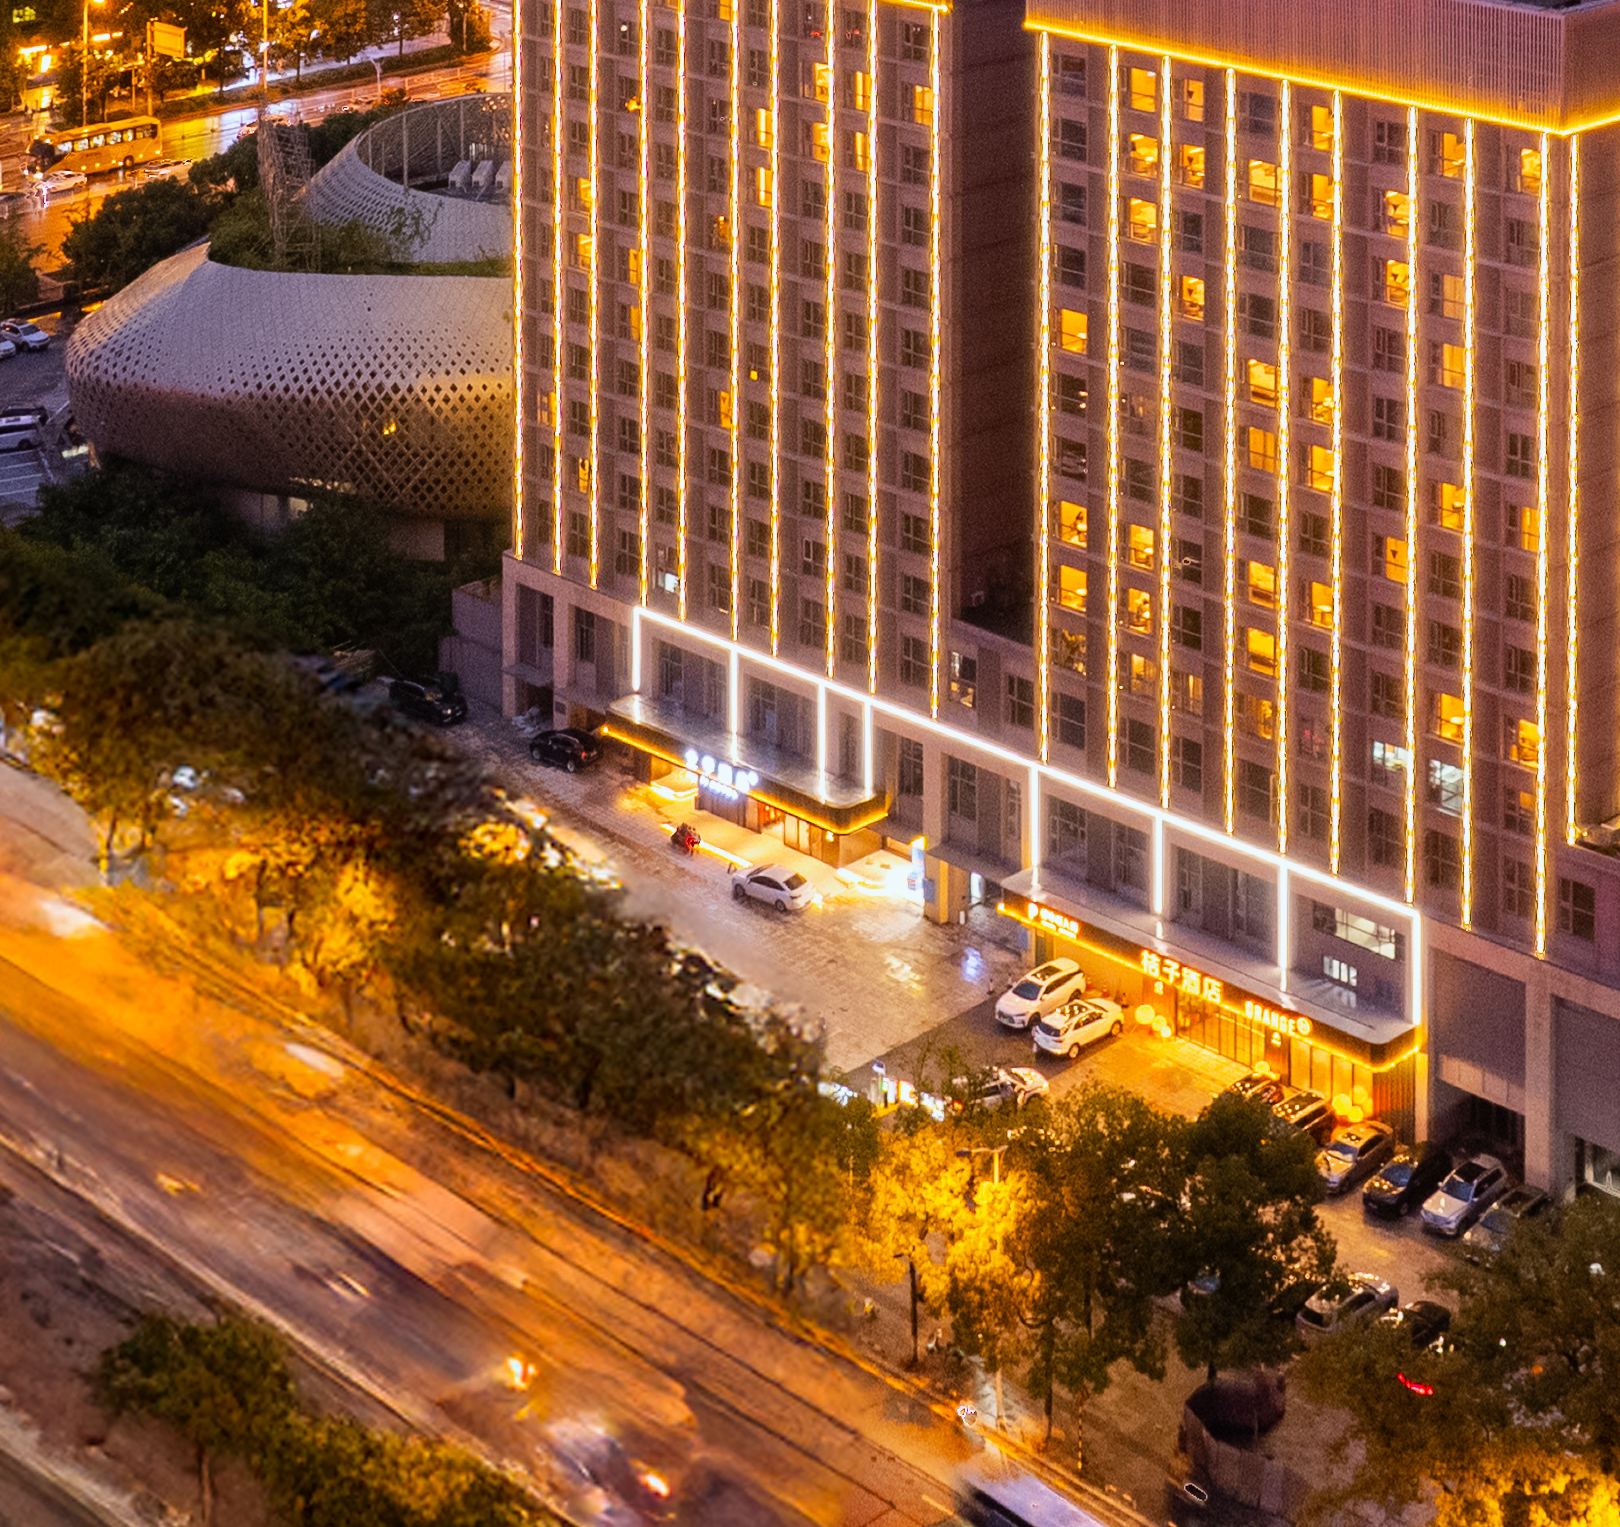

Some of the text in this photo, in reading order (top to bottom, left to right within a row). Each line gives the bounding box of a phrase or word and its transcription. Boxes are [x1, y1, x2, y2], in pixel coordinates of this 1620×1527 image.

[1141, 949, 1223, 1004] 桔子酒店
[1244, 1000, 1296, 1036] ORANGE
